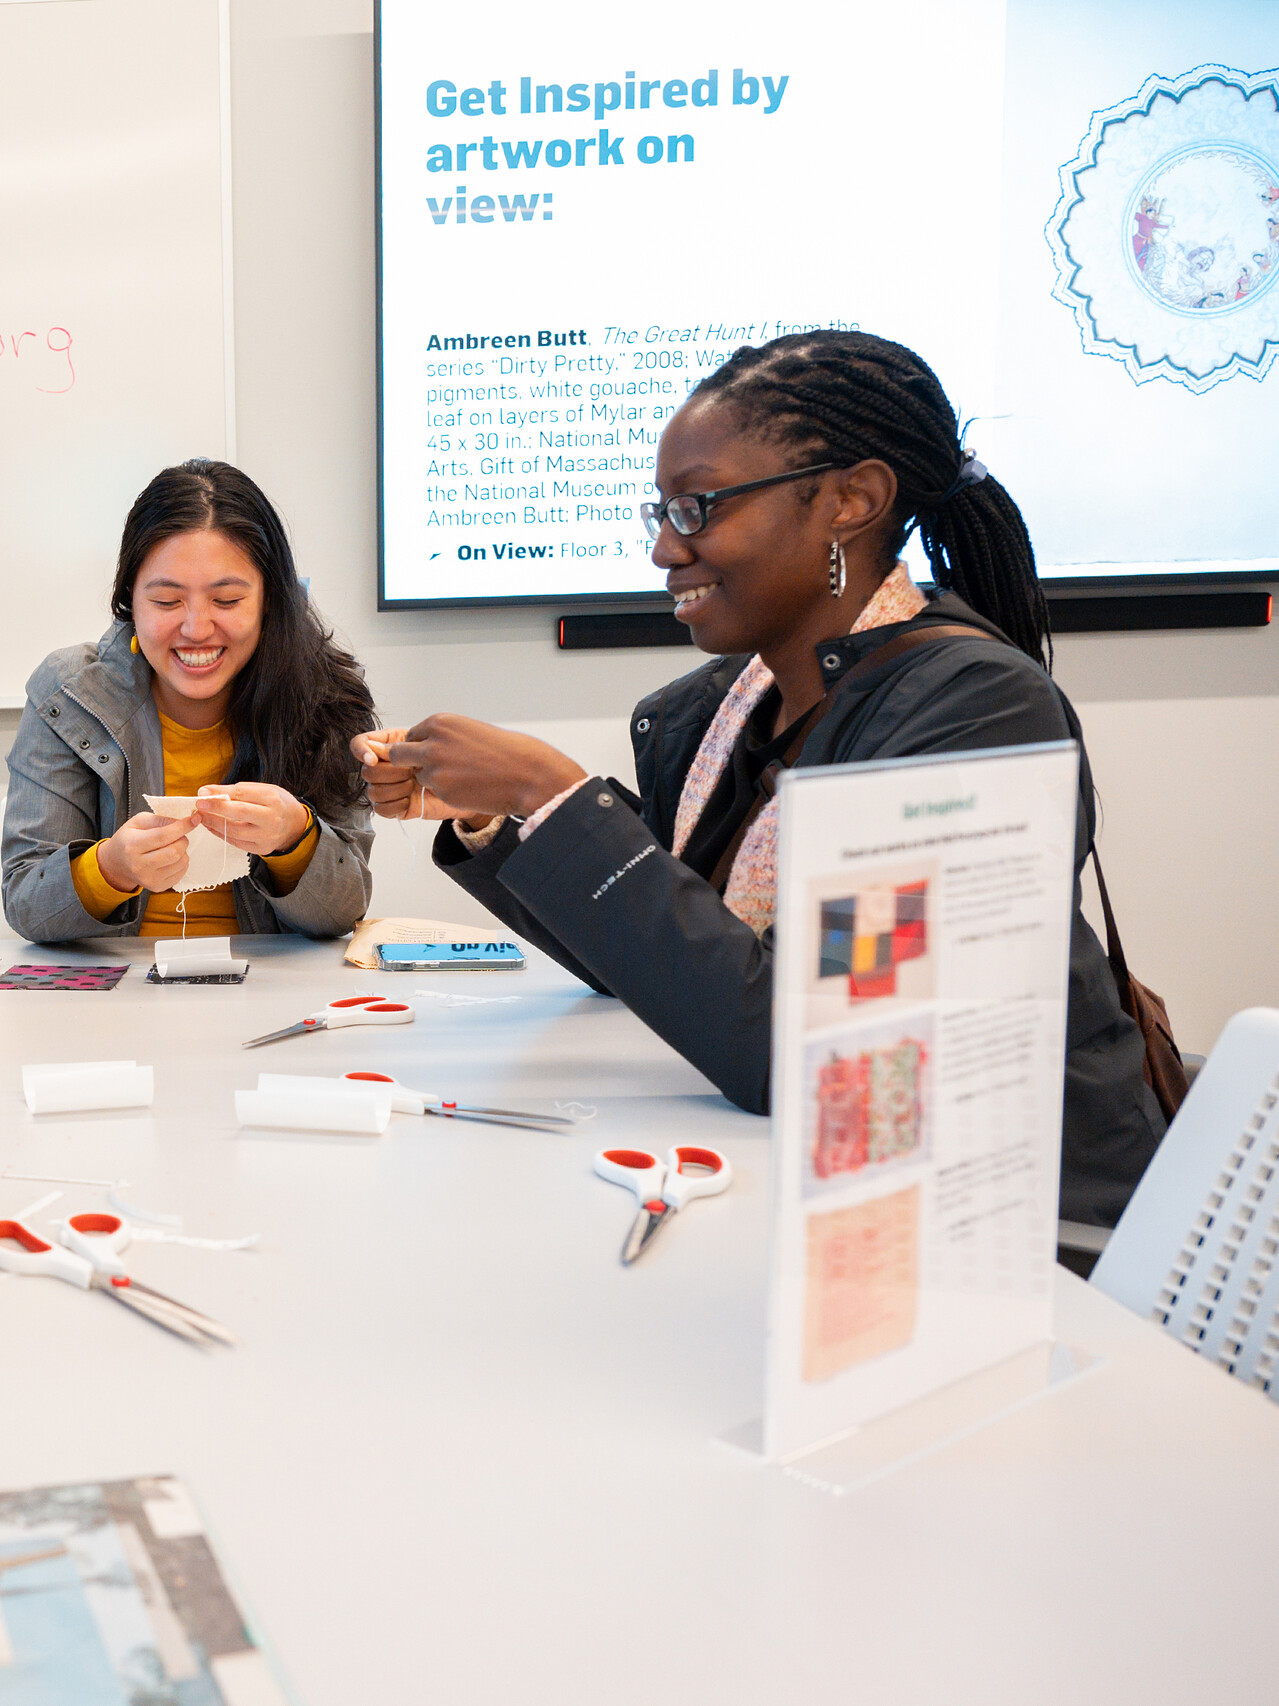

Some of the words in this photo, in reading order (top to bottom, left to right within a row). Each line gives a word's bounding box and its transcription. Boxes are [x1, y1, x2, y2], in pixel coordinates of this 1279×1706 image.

[425, 79, 507, 118] Get
[519, 68, 719, 121] Inspired
[731, 67, 791, 115] by
[425, 128, 625, 174] artwork
[636, 133, 695, 165] on
[425, 185, 554, 226] view:
[425, 332, 532, 352] Ambreen
[603, 326, 639, 345] The
[644, 324, 702, 344] Great
[704, 322, 756, 342] Hunt
[426, 362, 485, 378] series
[695, 349, 734, 367] Wat
[529, 379, 583, 399] white
[427, 407, 464, 428] leaf
[469, 412, 493, 426] on
[499, 407, 559, 429] layers
[565, 403, 585, 423] of
[591, 402, 647, 425] Mylar
[652, 405, 677, 420] an
[426, 433, 451, 452] 45
[457, 438, 468, 451] x
[474, 432, 499, 451] 30
[539, 427, 621, 449] National
[480, 456, 515, 476] Gift
[521, 455, 540, 474] of
[546, 452, 656, 473] Massachus
[426, 484, 458, 503] the
[464, 481, 547, 501] National
[553, 480, 636, 498] Museum
[426, 508, 517, 527] Ambreen
[576, 504, 633, 522] Photo
[456, 544, 487, 562] On
[491, 541, 554, 561] View:
[560, 541, 608, 558] Floor
[592, 844, 656, 900] OMNI-TECH
